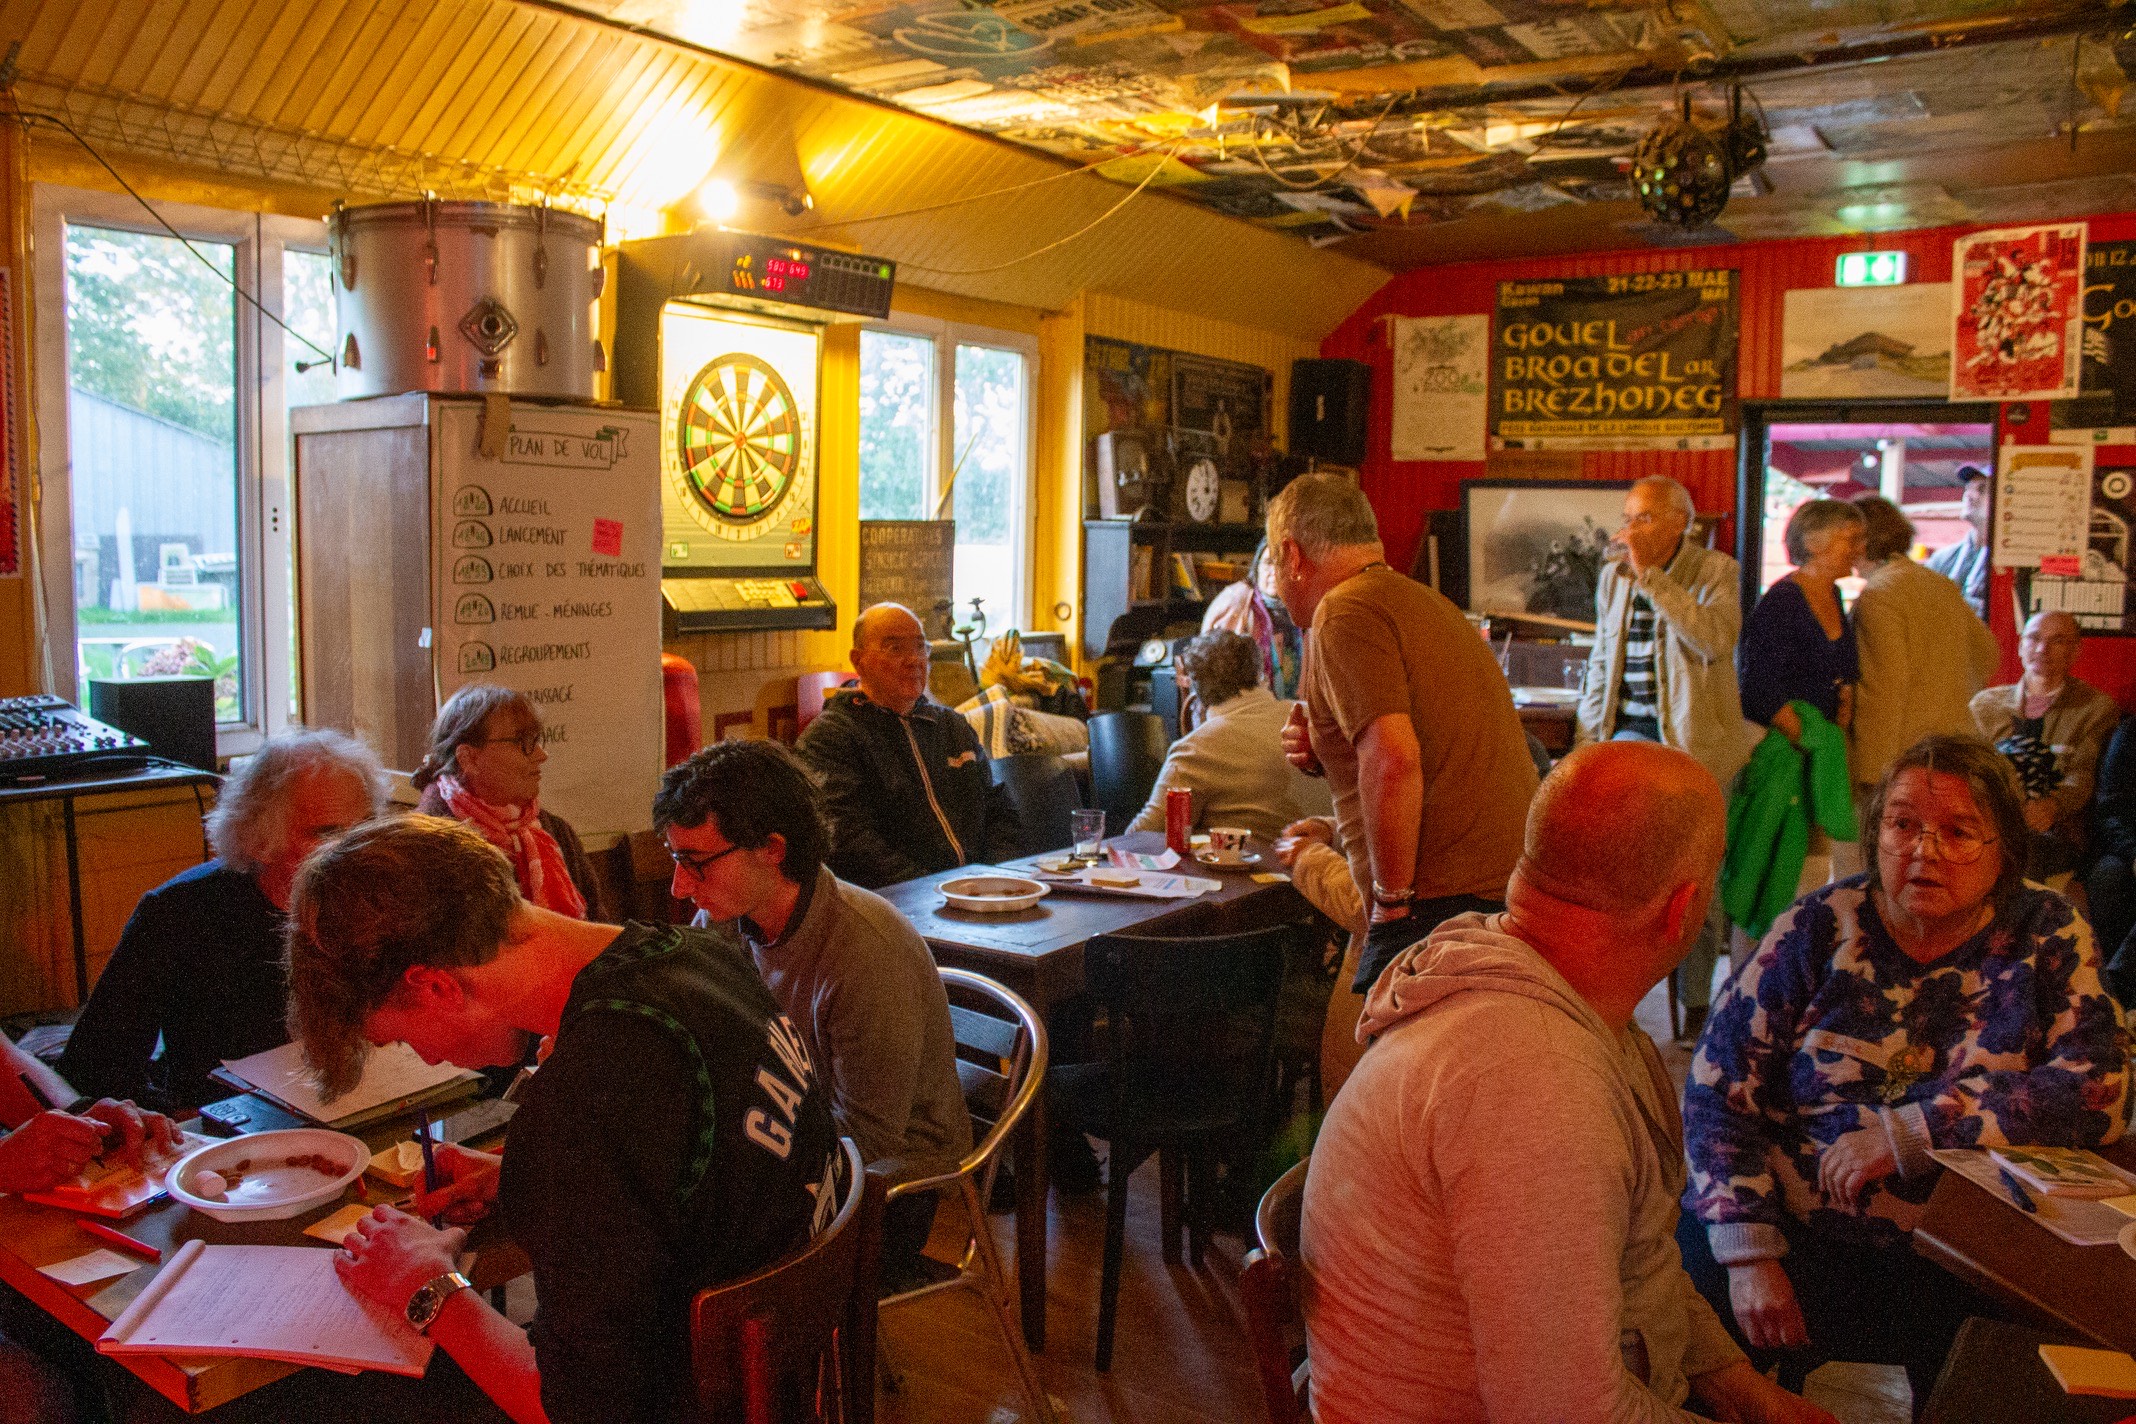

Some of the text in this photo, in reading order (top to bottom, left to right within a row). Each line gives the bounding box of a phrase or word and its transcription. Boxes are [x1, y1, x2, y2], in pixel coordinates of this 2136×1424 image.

[509, 435, 608, 460] PLAN DE VOL
[499, 496, 551, 516] ACCUEIL
[499, 526, 567, 547] LANCEMENT
[498, 561, 534, 580] CHOIX
[545, 561, 567, 578] DES
[499, 641, 592, 666] REGROUPEMENTS
